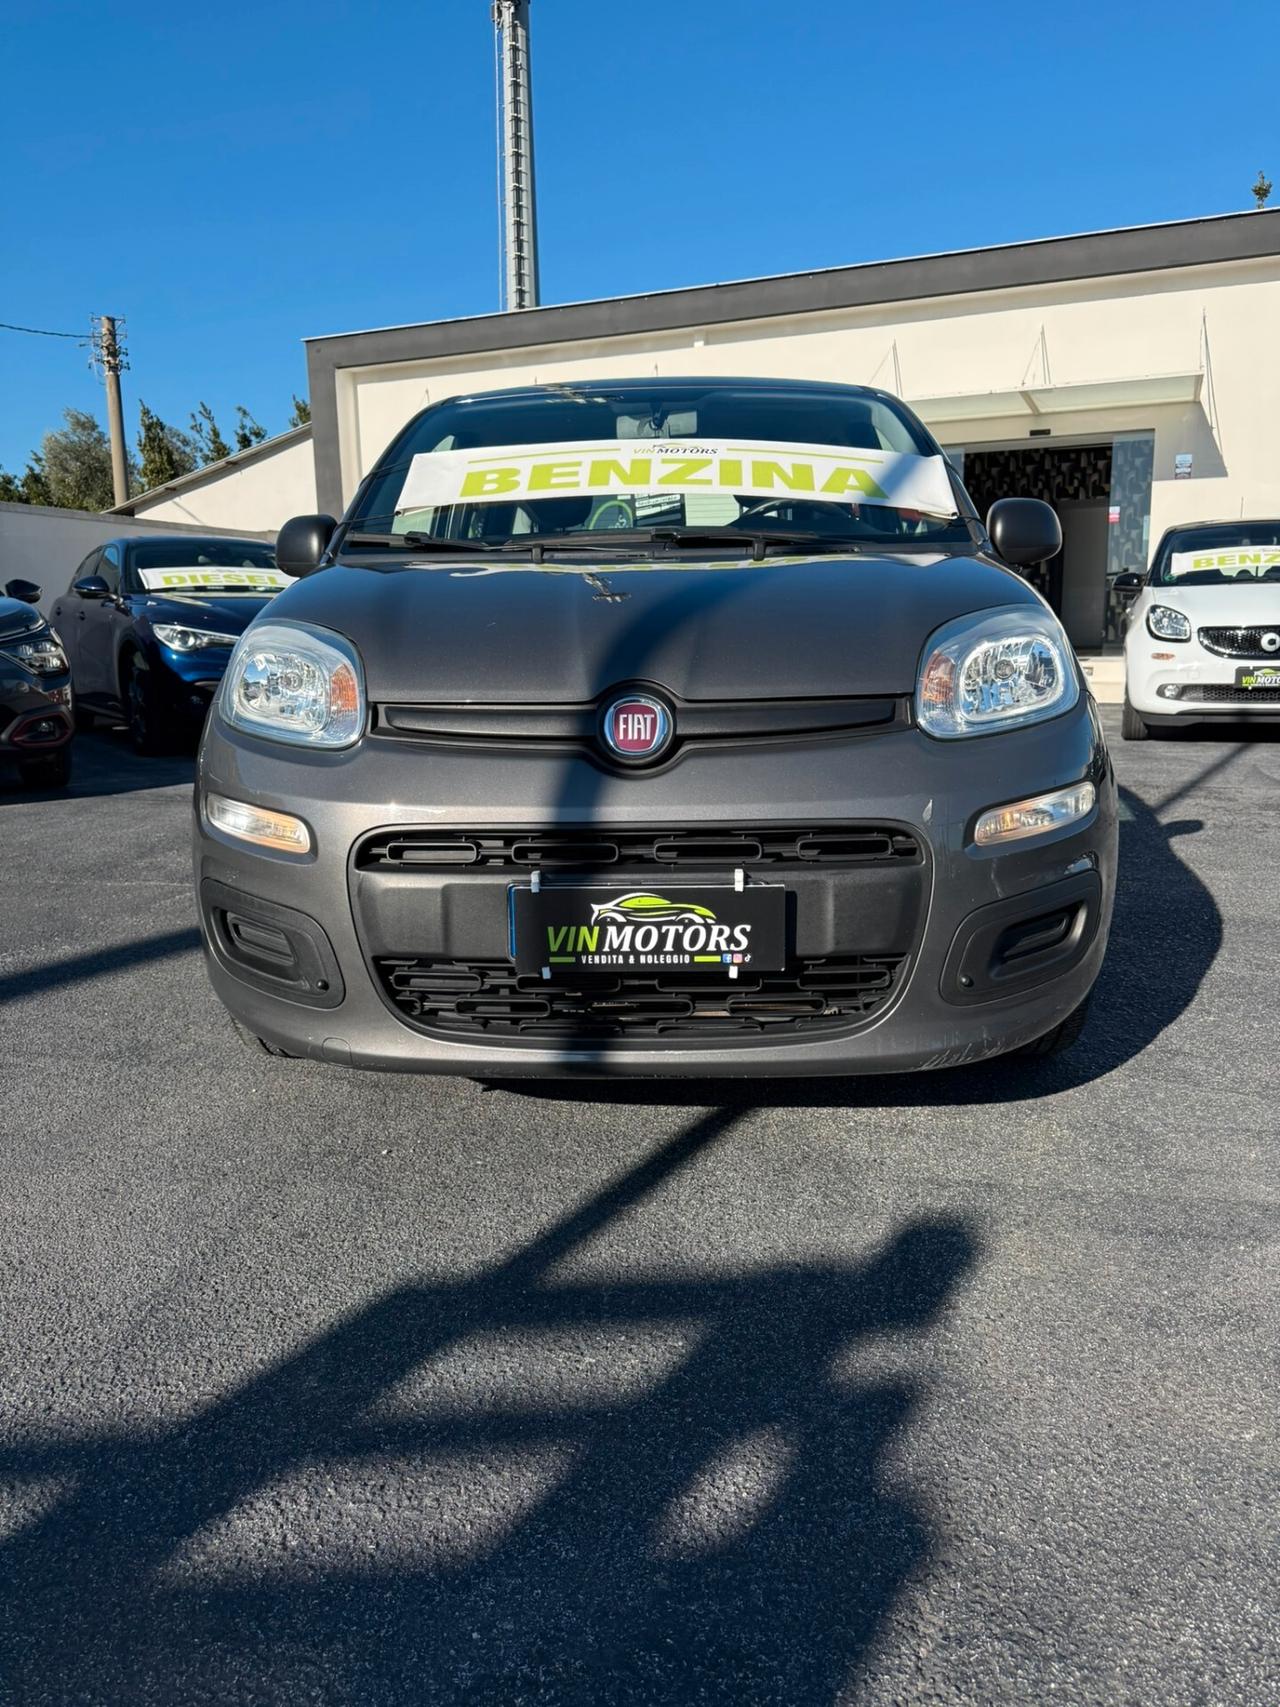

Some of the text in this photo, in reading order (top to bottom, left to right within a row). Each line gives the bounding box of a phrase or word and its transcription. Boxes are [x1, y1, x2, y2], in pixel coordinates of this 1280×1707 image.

[459, 459, 889, 499] BENZINA
[162, 573, 285, 585] DIESEL
[619, 713, 655, 740] FIAT
[581, 954, 690, 965] VENDITA & NOLEGGIO
